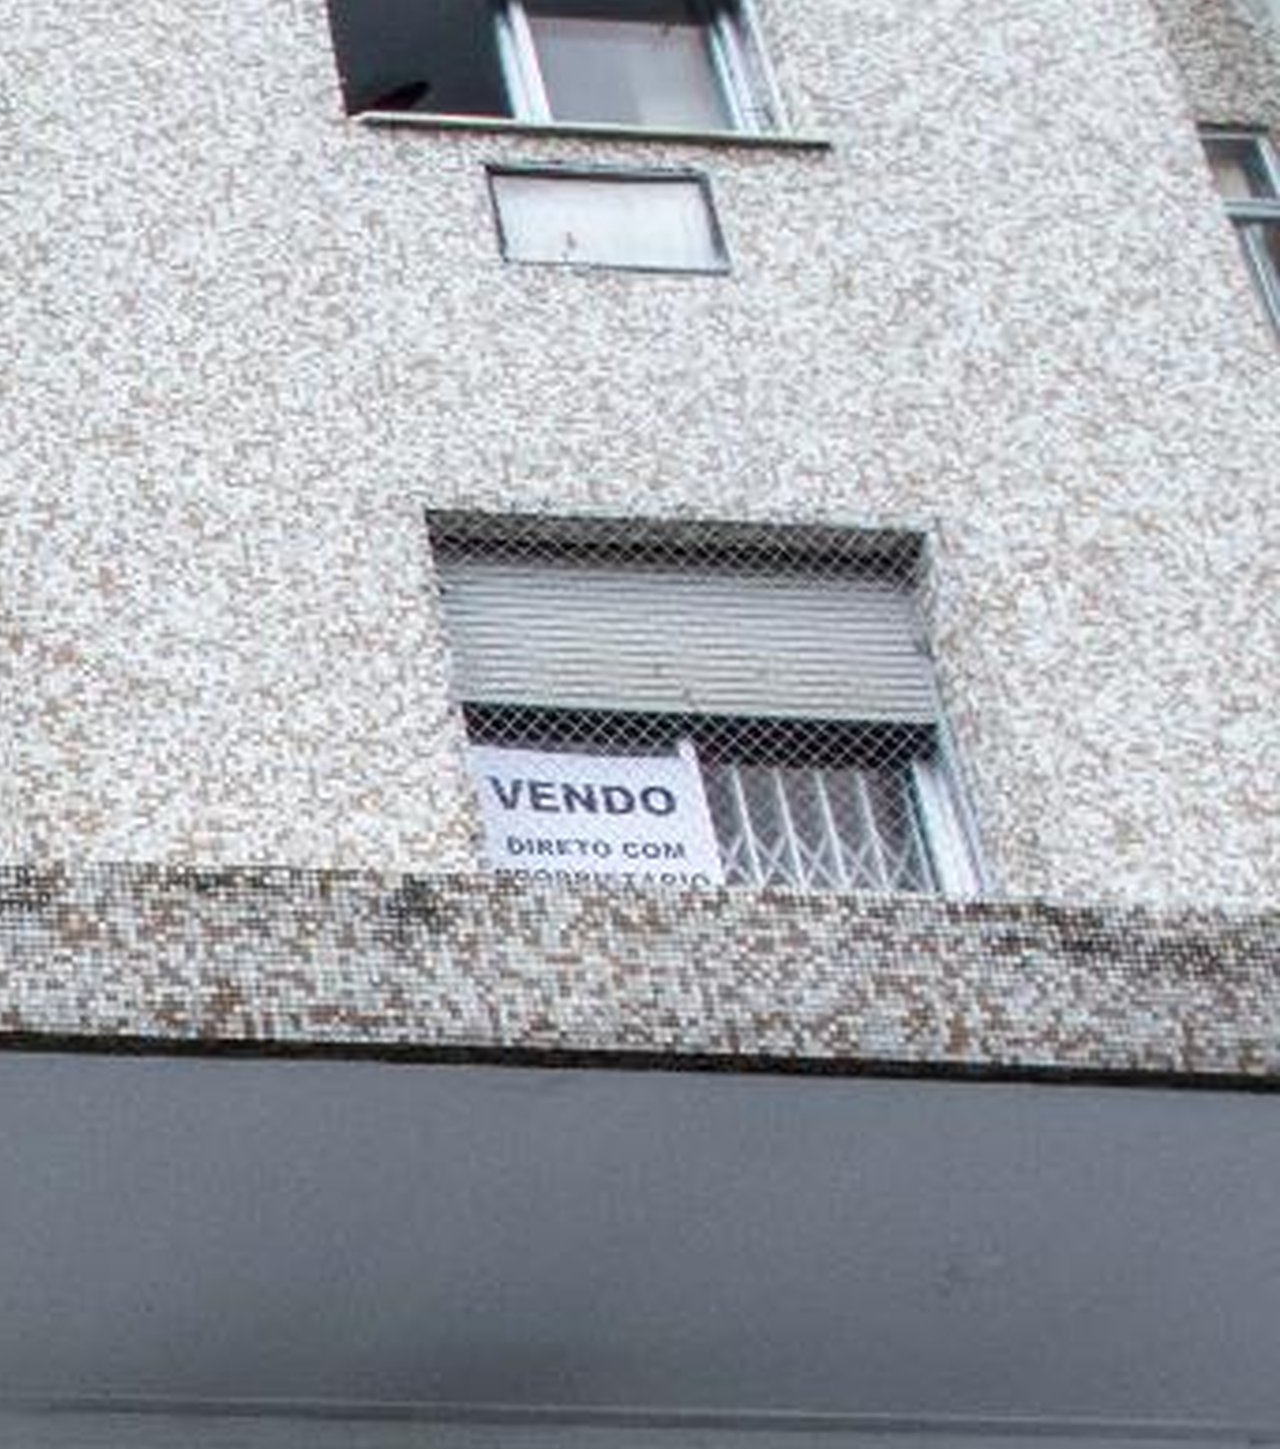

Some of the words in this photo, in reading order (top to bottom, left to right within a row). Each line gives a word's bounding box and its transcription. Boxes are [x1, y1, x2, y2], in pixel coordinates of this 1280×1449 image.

[488, 776, 678, 816] VENDO
[505, 836, 612, 859] DIRETO
[622, 841, 686, 860] COM
